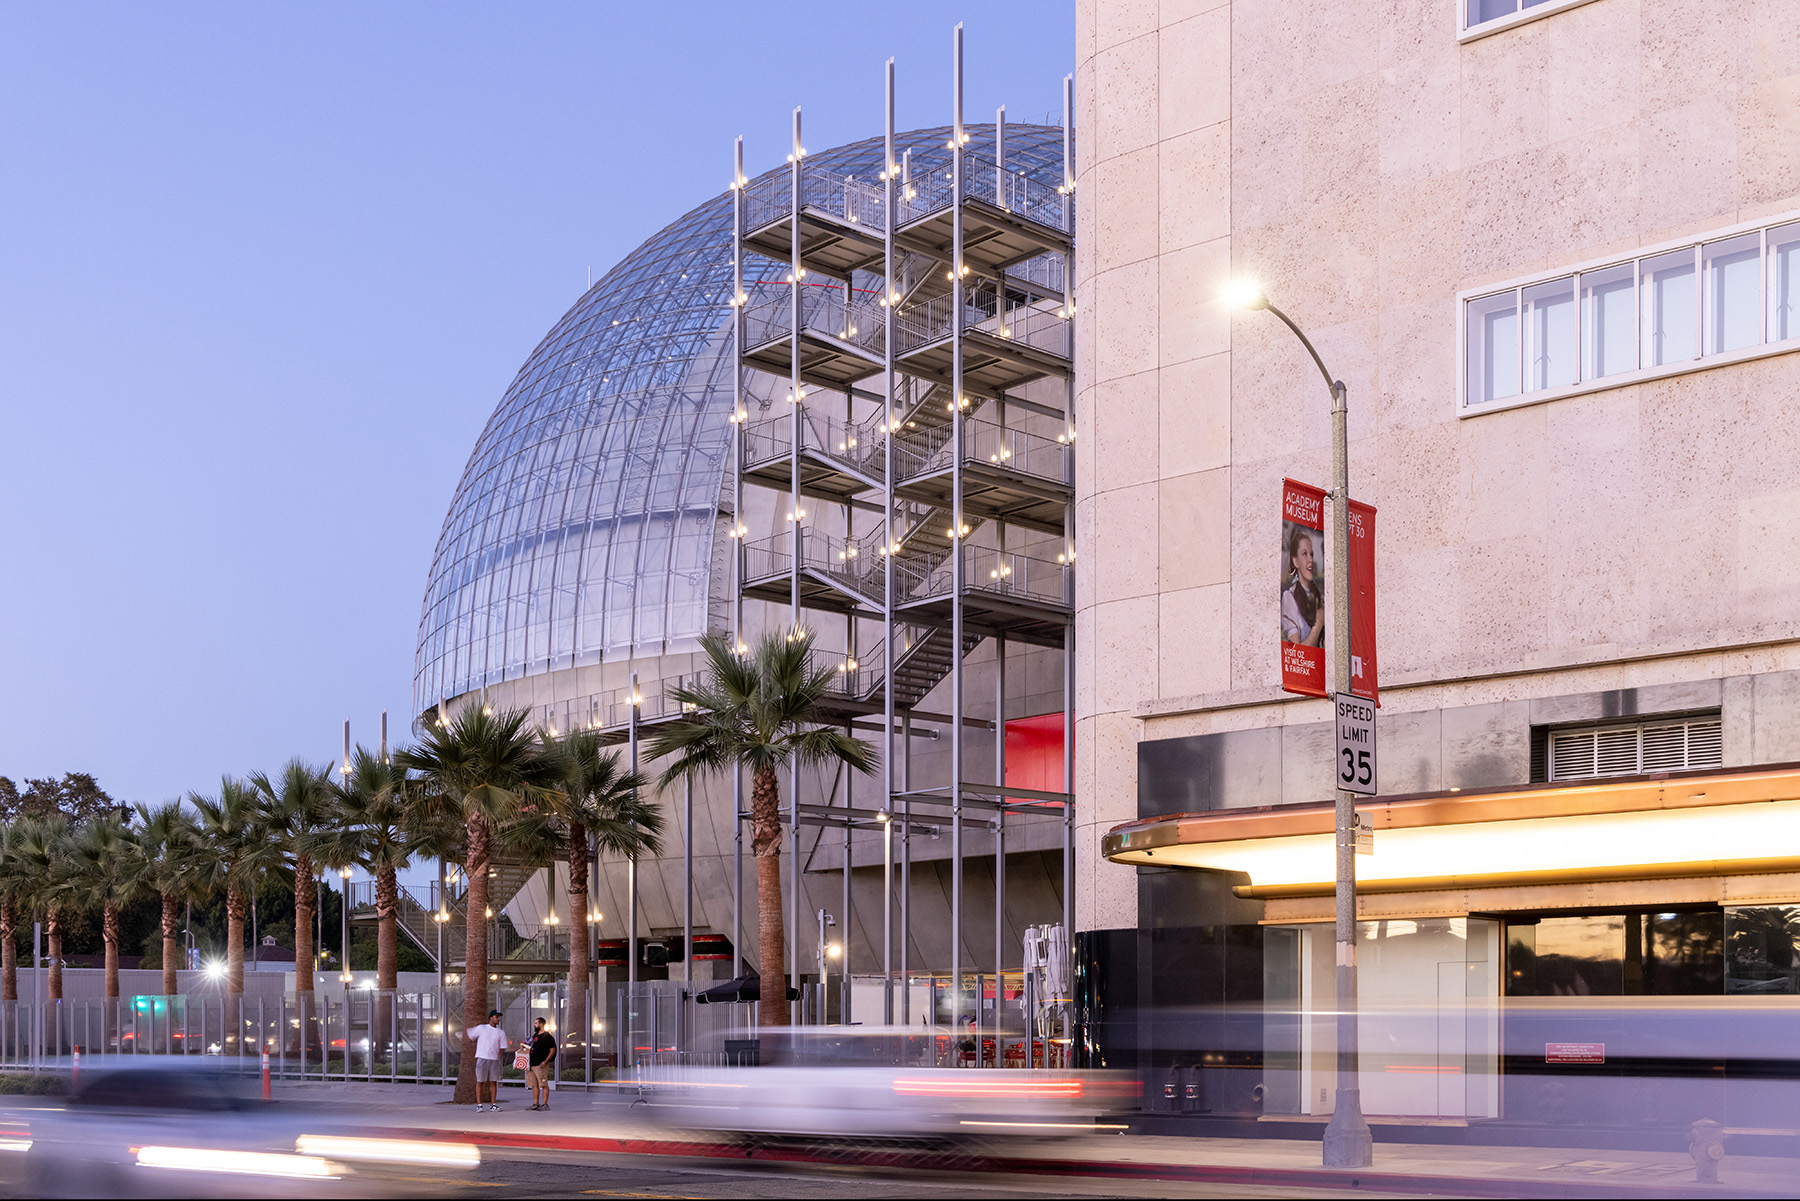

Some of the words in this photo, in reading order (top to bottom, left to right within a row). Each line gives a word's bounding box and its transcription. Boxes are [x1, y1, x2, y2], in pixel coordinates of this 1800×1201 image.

[1286, 492, 1320, 512] ACADEMY
[1286, 504, 1317, 523] MUSEUM
[1356, 526, 1365, 538] 30
[1284, 648, 1296, 657] VISIT
[1297, 651, 1305, 659] OZ
[1290, 665, 1310, 675] FAIRFAX
[1291, 659, 1316, 669] WILSHIRE
[1339, 703, 1372, 722] SPEED
[1343, 725, 1368, 743] LIMIT
[1341, 748, 1373, 785] 35
